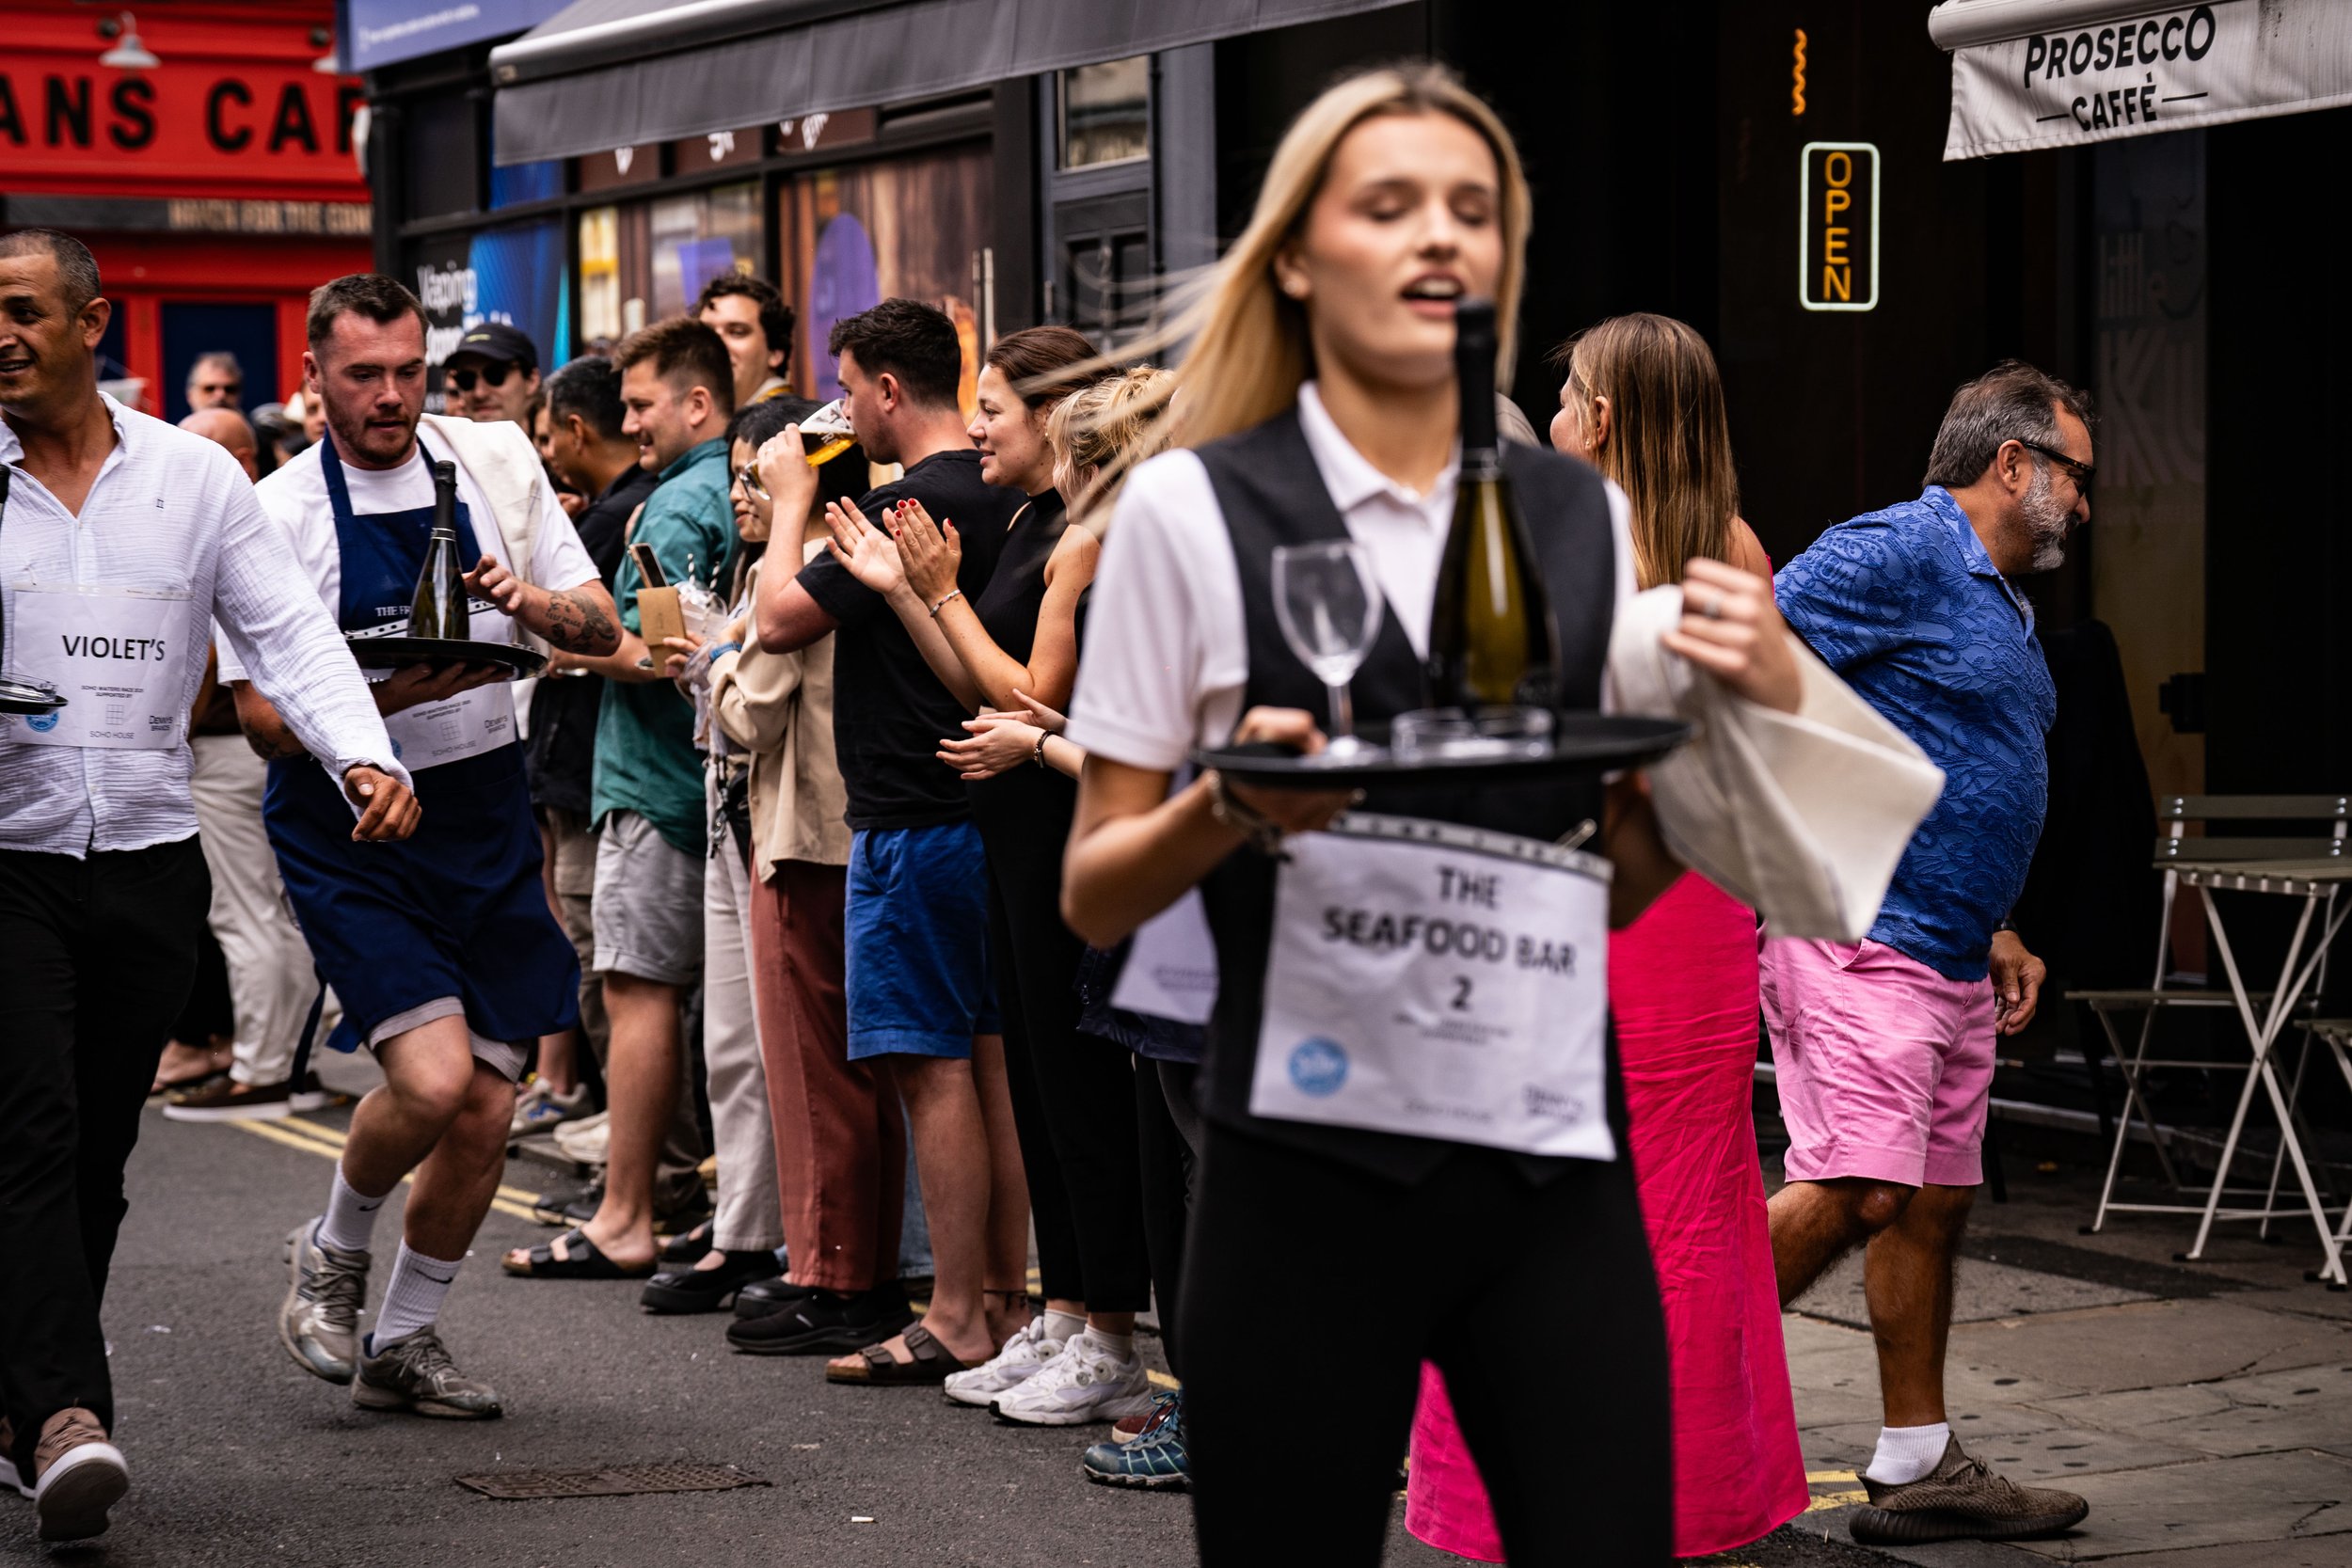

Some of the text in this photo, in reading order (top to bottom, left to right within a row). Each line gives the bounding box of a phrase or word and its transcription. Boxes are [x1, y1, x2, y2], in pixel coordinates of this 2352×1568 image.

[2024, 5, 2216, 88] PROSECCO
[1823, 150, 1851, 302] OPEN
[375, 606, 398, 617] THE
[62, 635, 166, 661] VIOLET'S
[432, 740, 476, 756] SOHO HOUSE
[1437, 863, 1501, 911] THE
[1321, 904, 1577, 979] SEAFOOD BAR
[1451, 974, 1473, 1012] 2
